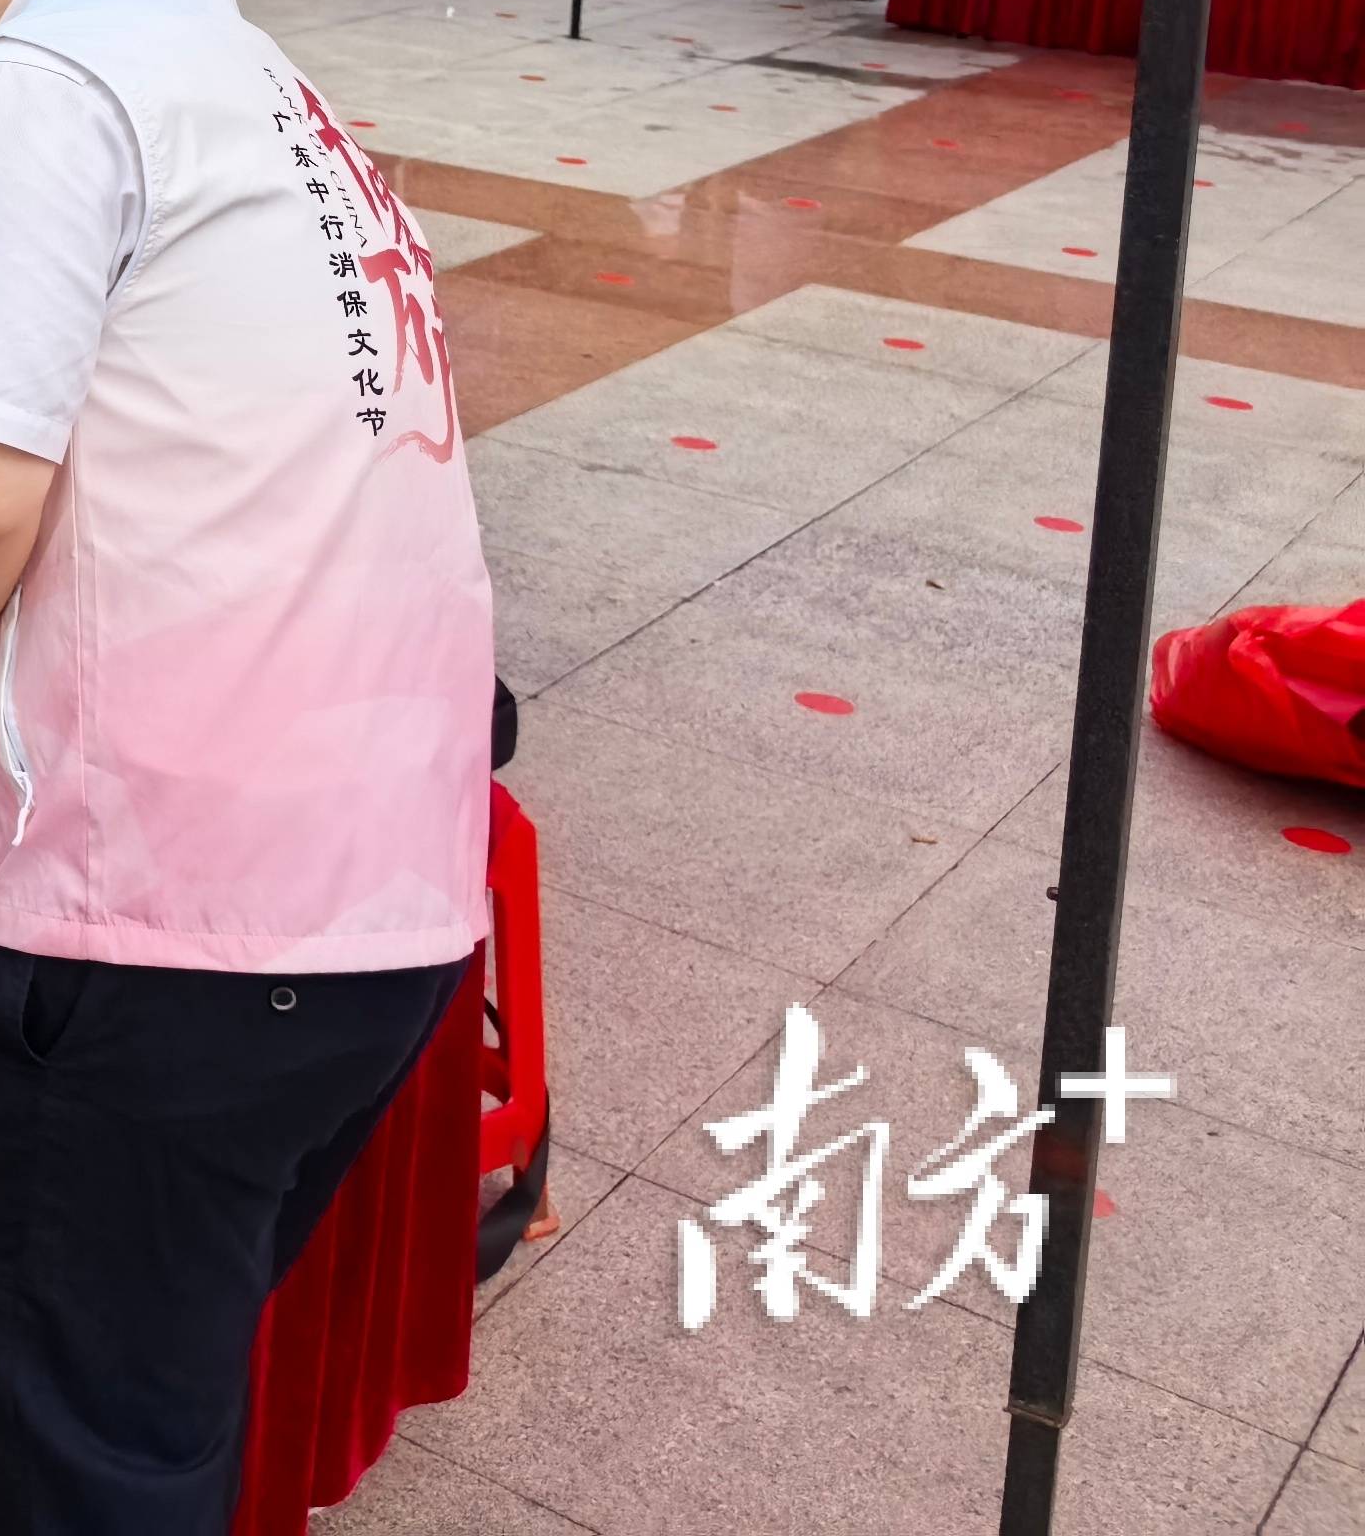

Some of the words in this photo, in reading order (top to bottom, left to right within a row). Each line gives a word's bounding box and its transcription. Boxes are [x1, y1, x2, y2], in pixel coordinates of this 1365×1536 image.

[272, 109, 387, 437] 广东中行消保文化节
